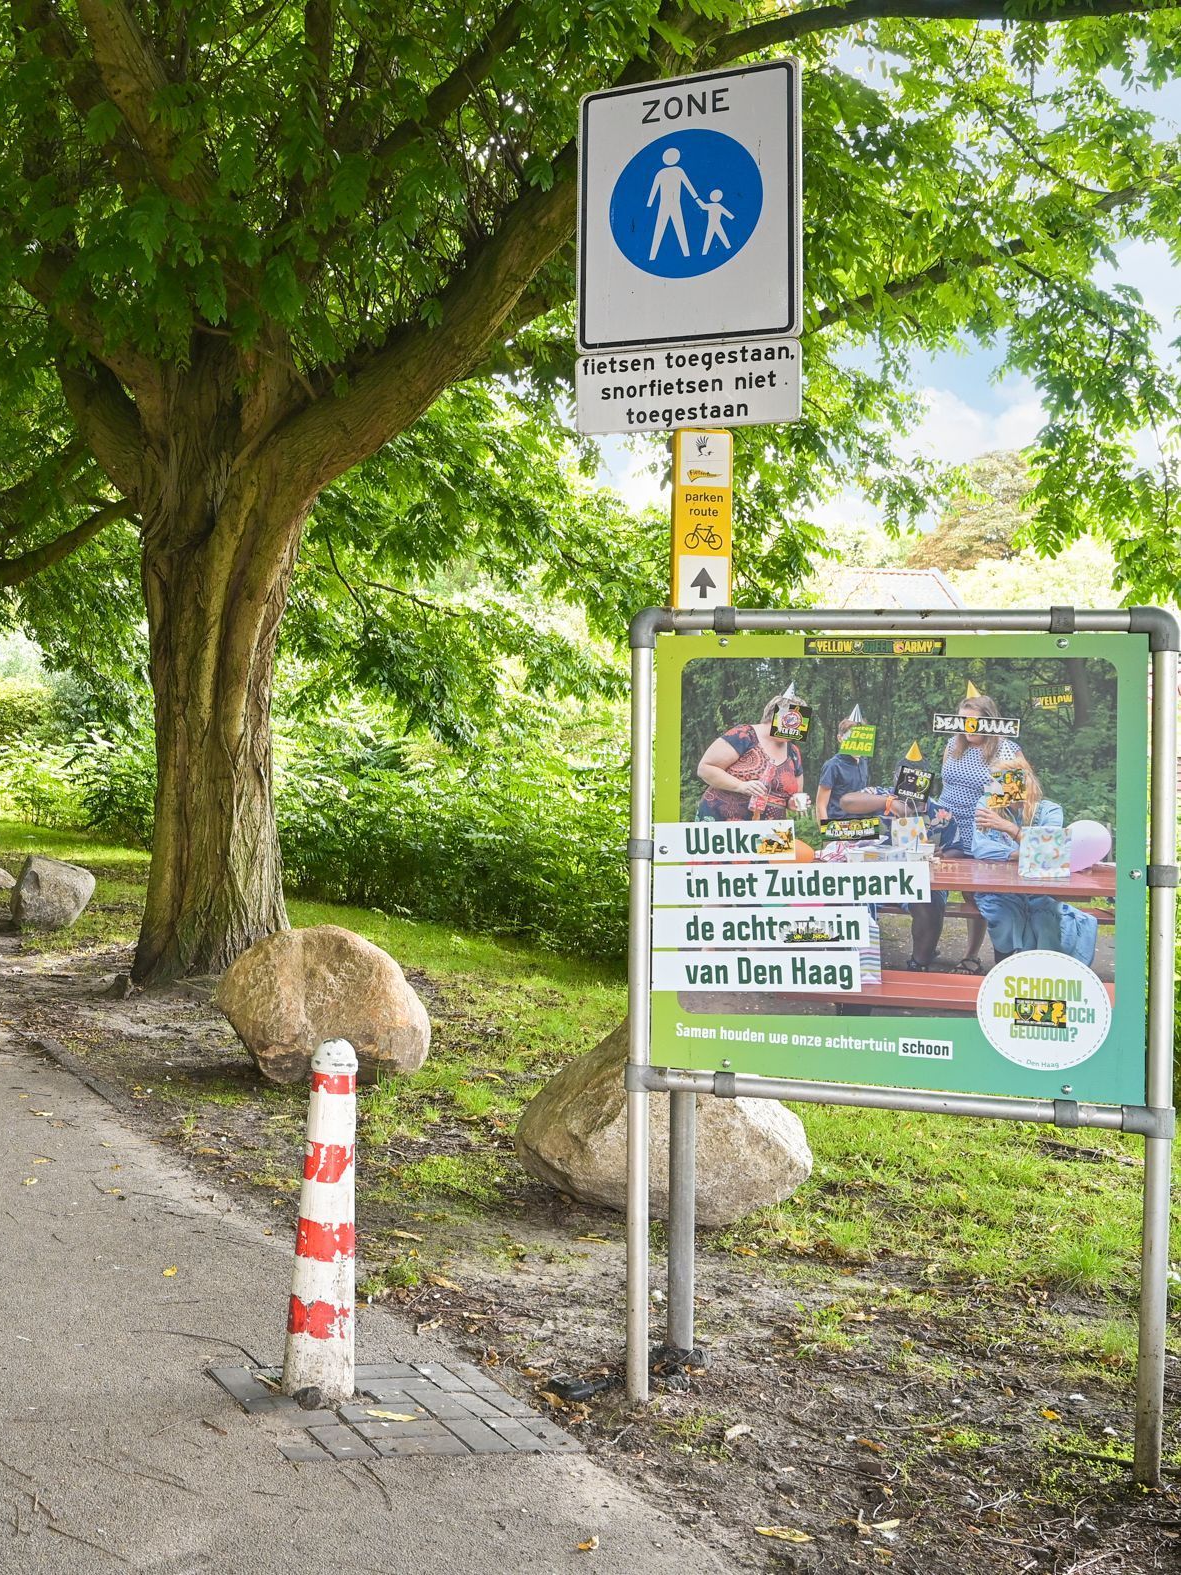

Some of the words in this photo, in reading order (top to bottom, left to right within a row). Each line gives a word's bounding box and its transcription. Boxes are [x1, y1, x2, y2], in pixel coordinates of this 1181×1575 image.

[641, 87, 730, 125] ZONE
[582, 357, 655, 376] fietsen
[665, 345, 795, 371] toegestaan,
[601, 378, 723, 400] snorfietsen
[735, 370, 777, 390] niet
[626, 402, 749, 428] toegestaan
[685, 491, 724, 503] parken
[689, 506, 719, 517] route
[816, 640, 853, 653] YELLOW
[904, 640, 934, 653] ARMY
[1039, 695, 1073, 706] YELLOW
[851, 731, 874, 740] Den
[935, 715, 966, 731] DEN
[978, 718, 1016, 734] HAAG
[840, 740, 873, 752] HAAG
[686, 872, 709, 898] in
[718, 871, 758, 898] het
[765, 868, 923, 901] Zuiderpark,
[686, 915, 715, 941] de
[685, 964, 729, 985] van
[737, 957, 783, 985] Den
[791, 957, 853, 991] Haag
[1004, 976, 1088, 1005] SCHOON,
[675, 1023, 717, 1040] Samen
[720, 1026, 765, 1043] houden
[769, 1032, 788, 1045] we
[791, 1034, 822, 1048] onze
[825, 1034, 897, 1053] achtertuin
[902, 1040, 950, 1057] schoon
[1026, 1059, 1040, 1068] Den
[1041, 1061, 1060, 1069] Haag
